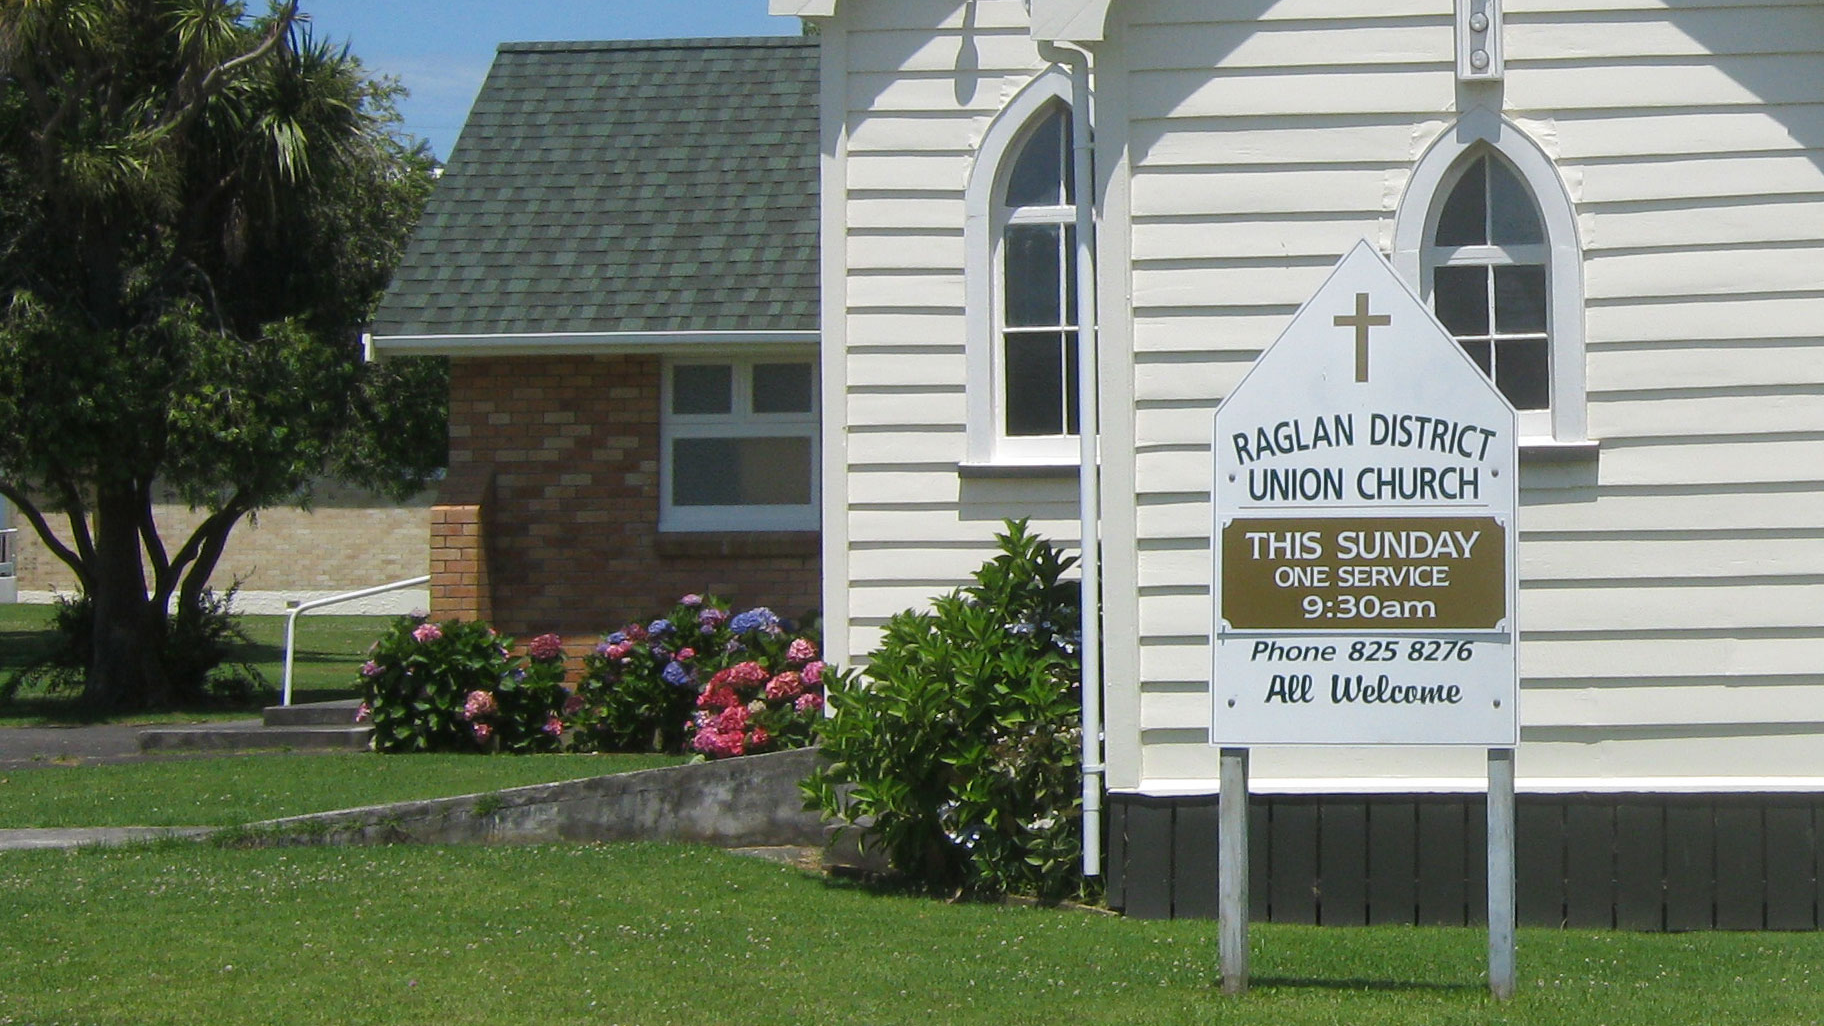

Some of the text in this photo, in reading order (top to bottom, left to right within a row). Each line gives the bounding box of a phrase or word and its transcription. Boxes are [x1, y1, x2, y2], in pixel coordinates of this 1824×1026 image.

[1232, 413, 1497, 465] RAGLAN DISTRICT
[1249, 466, 1479, 501] UNION CHURCH
[1245, 531, 1481, 560] THIS SUNDAY
[1274, 566, 1451, 588] ONE SERVICE
[1302, 595, 1437, 619] 9:30am
[1251, 640, 1474, 662] Phone 825 8276
[1264, 674, 1463, 705] All Welcome
